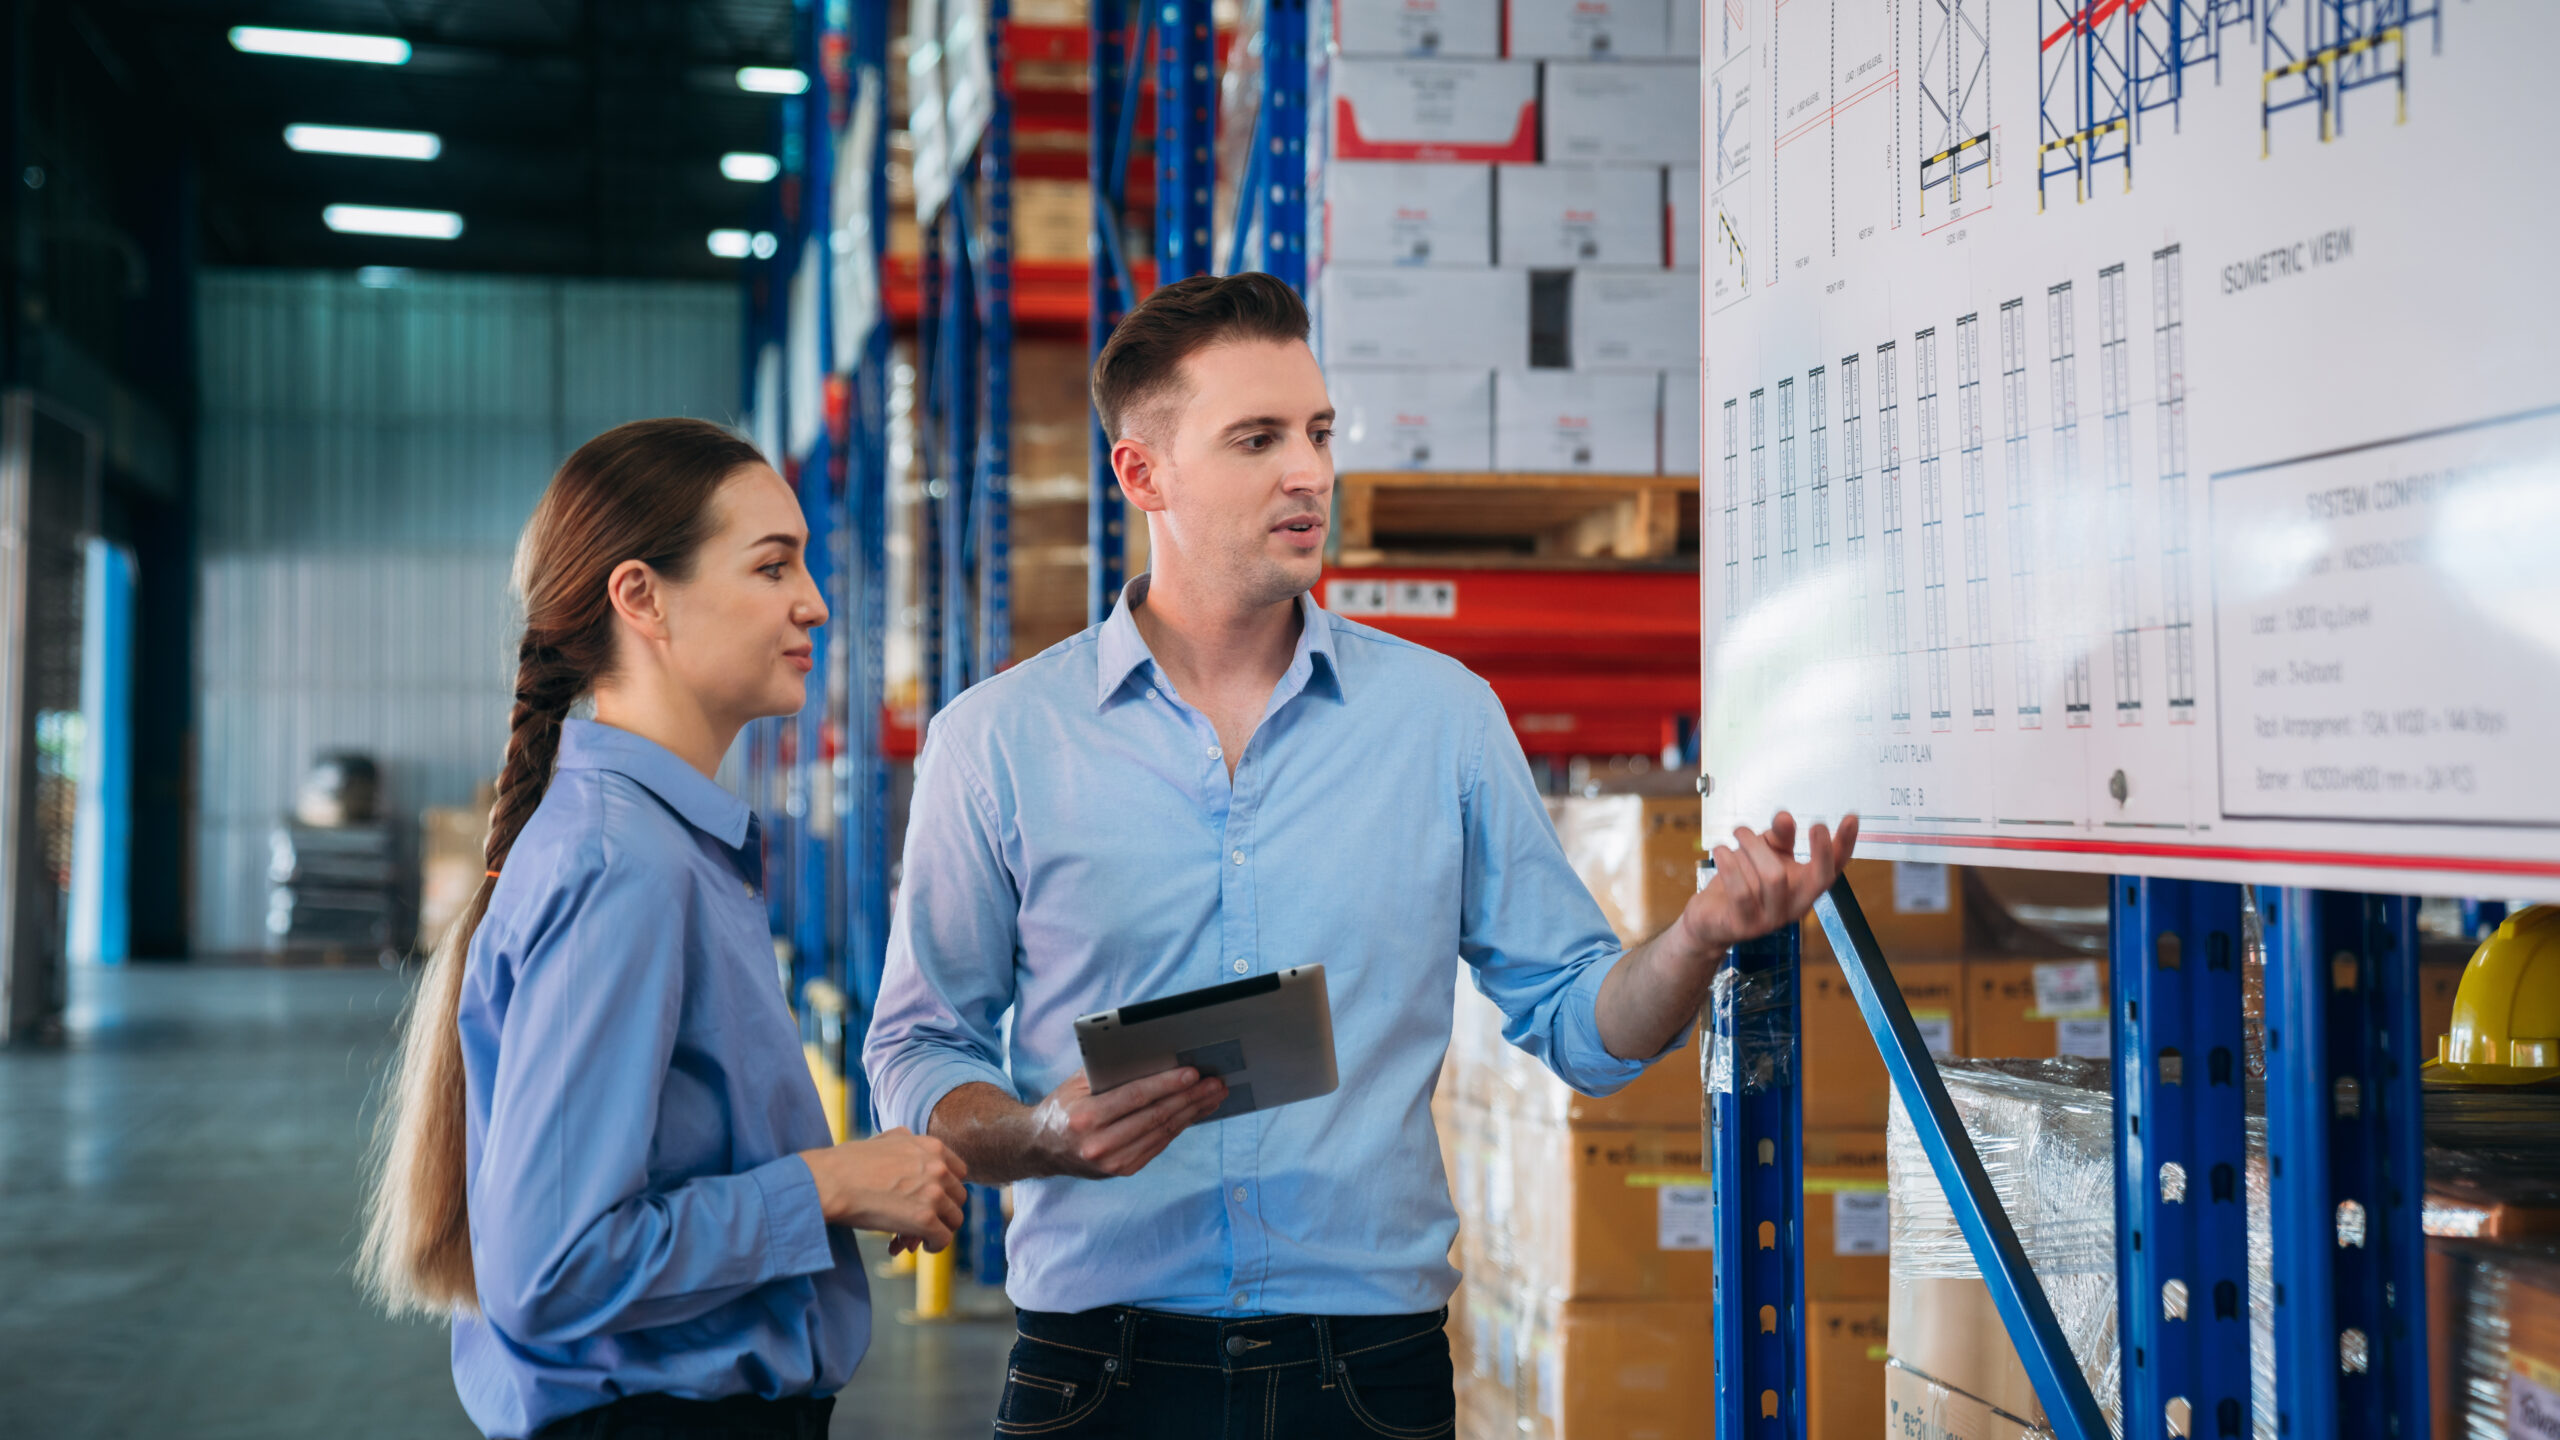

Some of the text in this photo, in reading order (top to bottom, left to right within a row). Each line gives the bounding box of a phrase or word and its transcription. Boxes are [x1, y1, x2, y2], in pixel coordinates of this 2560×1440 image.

[2220, 225, 2354, 295] ISOMETRIC VIEW
[2305, 484, 2368, 520] SYSTEM
[1879, 743, 1932, 763] LAYOUT PLAN
[1890, 787, 1910, 806] ZONE
[1918, 787, 1924, 806] B
